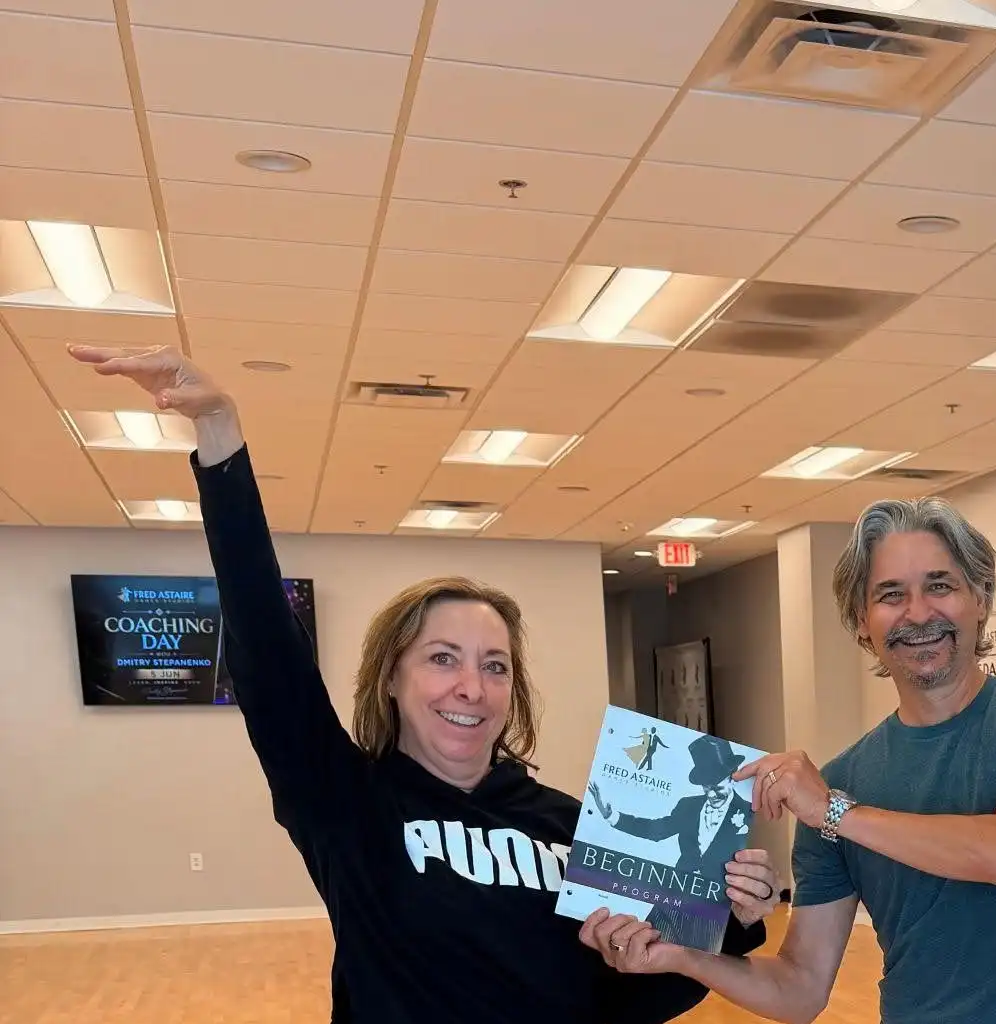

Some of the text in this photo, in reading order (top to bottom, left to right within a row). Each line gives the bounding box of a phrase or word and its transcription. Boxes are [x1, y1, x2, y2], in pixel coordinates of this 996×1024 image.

[664, 543, 690, 565] EXIT
[133, 590, 195, 600] FRED ASTAIRE
[104, 617, 214, 633] COACHING
[141, 634, 183, 650] DAY
[117, 659, 212, 667] DMITRY STEPANENKO
[603, 763, 629, 778] FRED
[630, 772, 673, 791] ASTAIRE
[403, 819, 572, 892] PUM
[582, 846, 721, 902] BEGINNER
[612, 882, 683, 908] PROGRAM
